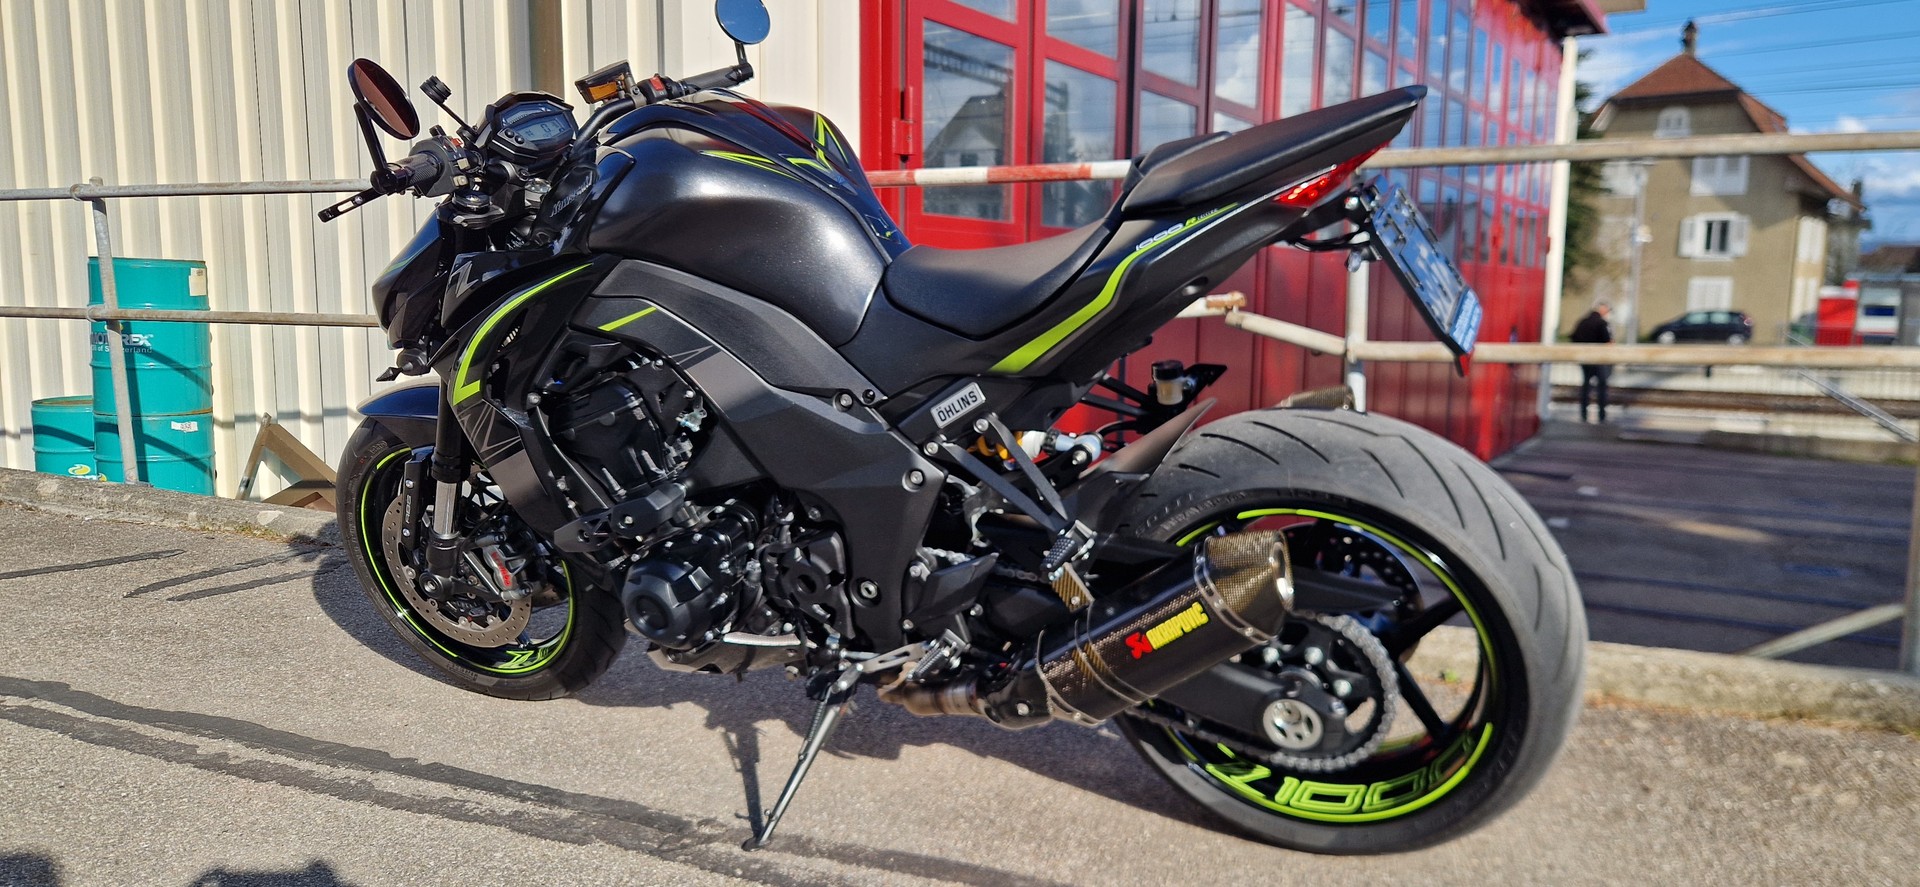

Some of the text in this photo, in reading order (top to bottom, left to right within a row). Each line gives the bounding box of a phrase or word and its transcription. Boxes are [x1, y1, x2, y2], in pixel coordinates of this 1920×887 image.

[1135, 222, 1184, 251] 1000
[90, 332, 153, 347] MOTREX
[105, 345, 152, 354] Serland
[935, 390, 978, 422] ÖHLINS
